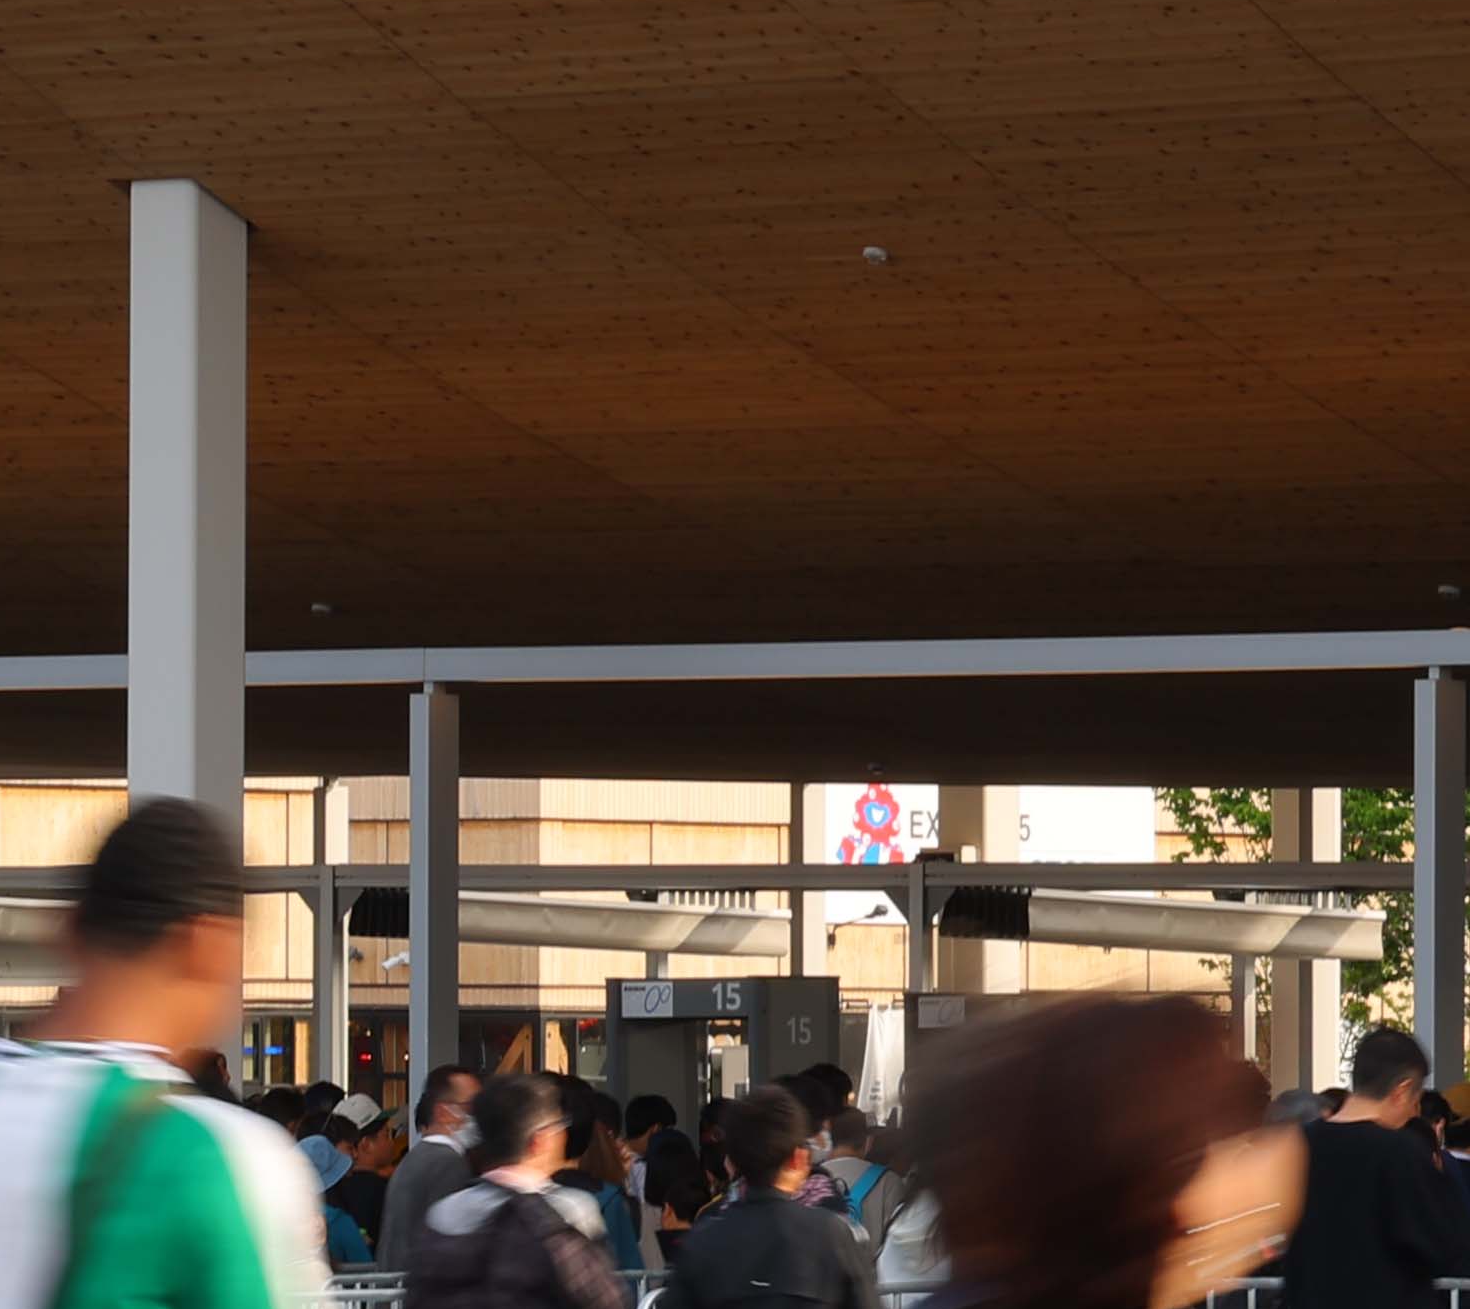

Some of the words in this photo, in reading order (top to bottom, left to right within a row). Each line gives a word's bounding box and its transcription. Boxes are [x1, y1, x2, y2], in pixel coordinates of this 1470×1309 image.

[909, 810, 939, 839] EX
[712, 982, 741, 1010] 15
[786, 1017, 812, 1045] 15
